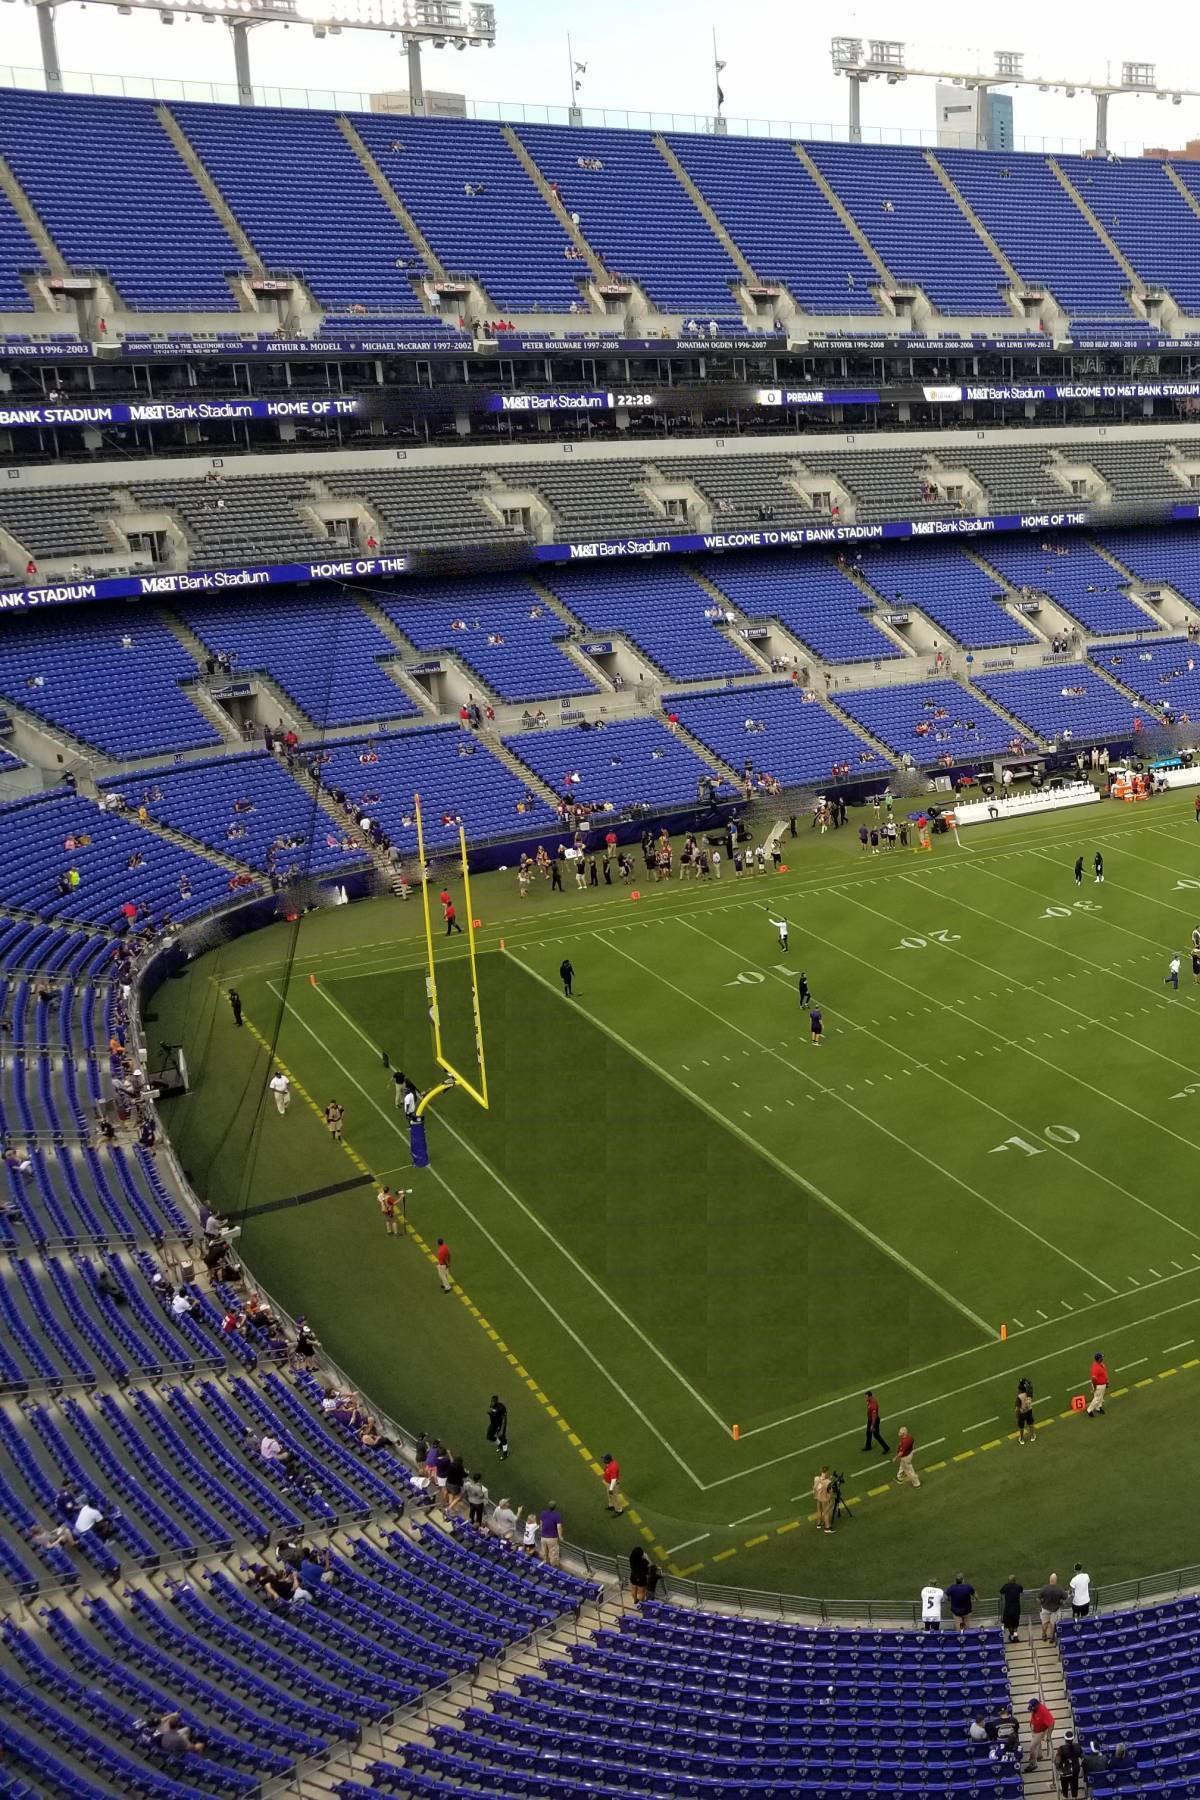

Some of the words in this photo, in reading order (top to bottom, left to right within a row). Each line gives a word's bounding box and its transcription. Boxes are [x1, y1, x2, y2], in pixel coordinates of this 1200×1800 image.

[8, 346, 38, 354] BYNER
[40, 345, 89, 354] 1996-2003
[266, 343, 299, 351] ARTHUR
[397, 342, 431, 350] McCRARY
[433, 342, 473, 350] 1997-2002
[546, 341, 582, 349] BOULWARE
[583, 341, 619, 349] 1997-2005
[676, 341, 709, 349] JONATHAN
[711, 341, 733, 349] OGDEN
[734, 341, 767, 349] 1996-2007
[813, 341, 829, 349] MATT
[830, 341, 852, 349] STOVER
[853, 341, 885, 349] 1996-2008
[907, 341, 925, 349] JAMAL
[926, 341, 944, 349] LEWIS
[787, 391, 824, 402] PREGAME
[967, 388, 989, 400] M&T
[990, 387, 1011, 399] Bank
[1011, 387, 1045, 399] Stadium
[1056, 386, 1101, 398] WELCOME
[1103, 386, 1115, 397] TO
[1118, 386, 1137, 397] M&T
[1138, 385, 1161, 396] BANK
[1163, 384, 1199, 396] STADIUM
[502, 396, 531, 410] M&T
[531, 396, 558, 408] Bank
[558, 394, 602, 407] Stadium
[618, 394, 652, 406] 22:28
[130, 406, 164, 420] M&T
[166, 405, 198, 418] Bank
[198, 404, 252, 418] Stadium
[268, 402, 309, 415] HOME
[312, 401, 331, 414] OF
[0, 410, 41, 424] BANK
[44, 408, 112, 422] STADIUM
[911, 521, 936, 535] M&T
[936, 520, 958, 532] Bank
[959, 519, 994, 531] Stadium
[1021, 516, 1048, 527] HOME
[1051, 514, 1064, 526] OF
[1067, 513, 1084, 524] THE
[704, 533, 761, 548] WELCOME
[763, 532, 778, 544] TO
[781, 530, 803, 543] M&T
[806, 528, 836, 541] BANK
[838, 525, 883, 539] STADIUM
[570, 544, 599, 558] M&T
[600, 542, 626, 556] Bank
[627, 540, 671, 553] Stadium
[311, 562, 353, 578] HOME
[355, 560, 375, 574] OF
[378, 558, 405, 572] THE
[141, 576, 179, 593] M&T
[179, 575, 214, 590] Bank
[214, 570, 269, 586] Stadium
[28, 585, 96, 604] STADIUM
[900, 929, 962, 949] 20
[1003, 1124, 1080, 1158] 10
[927, 1596, 934, 1610] 5
